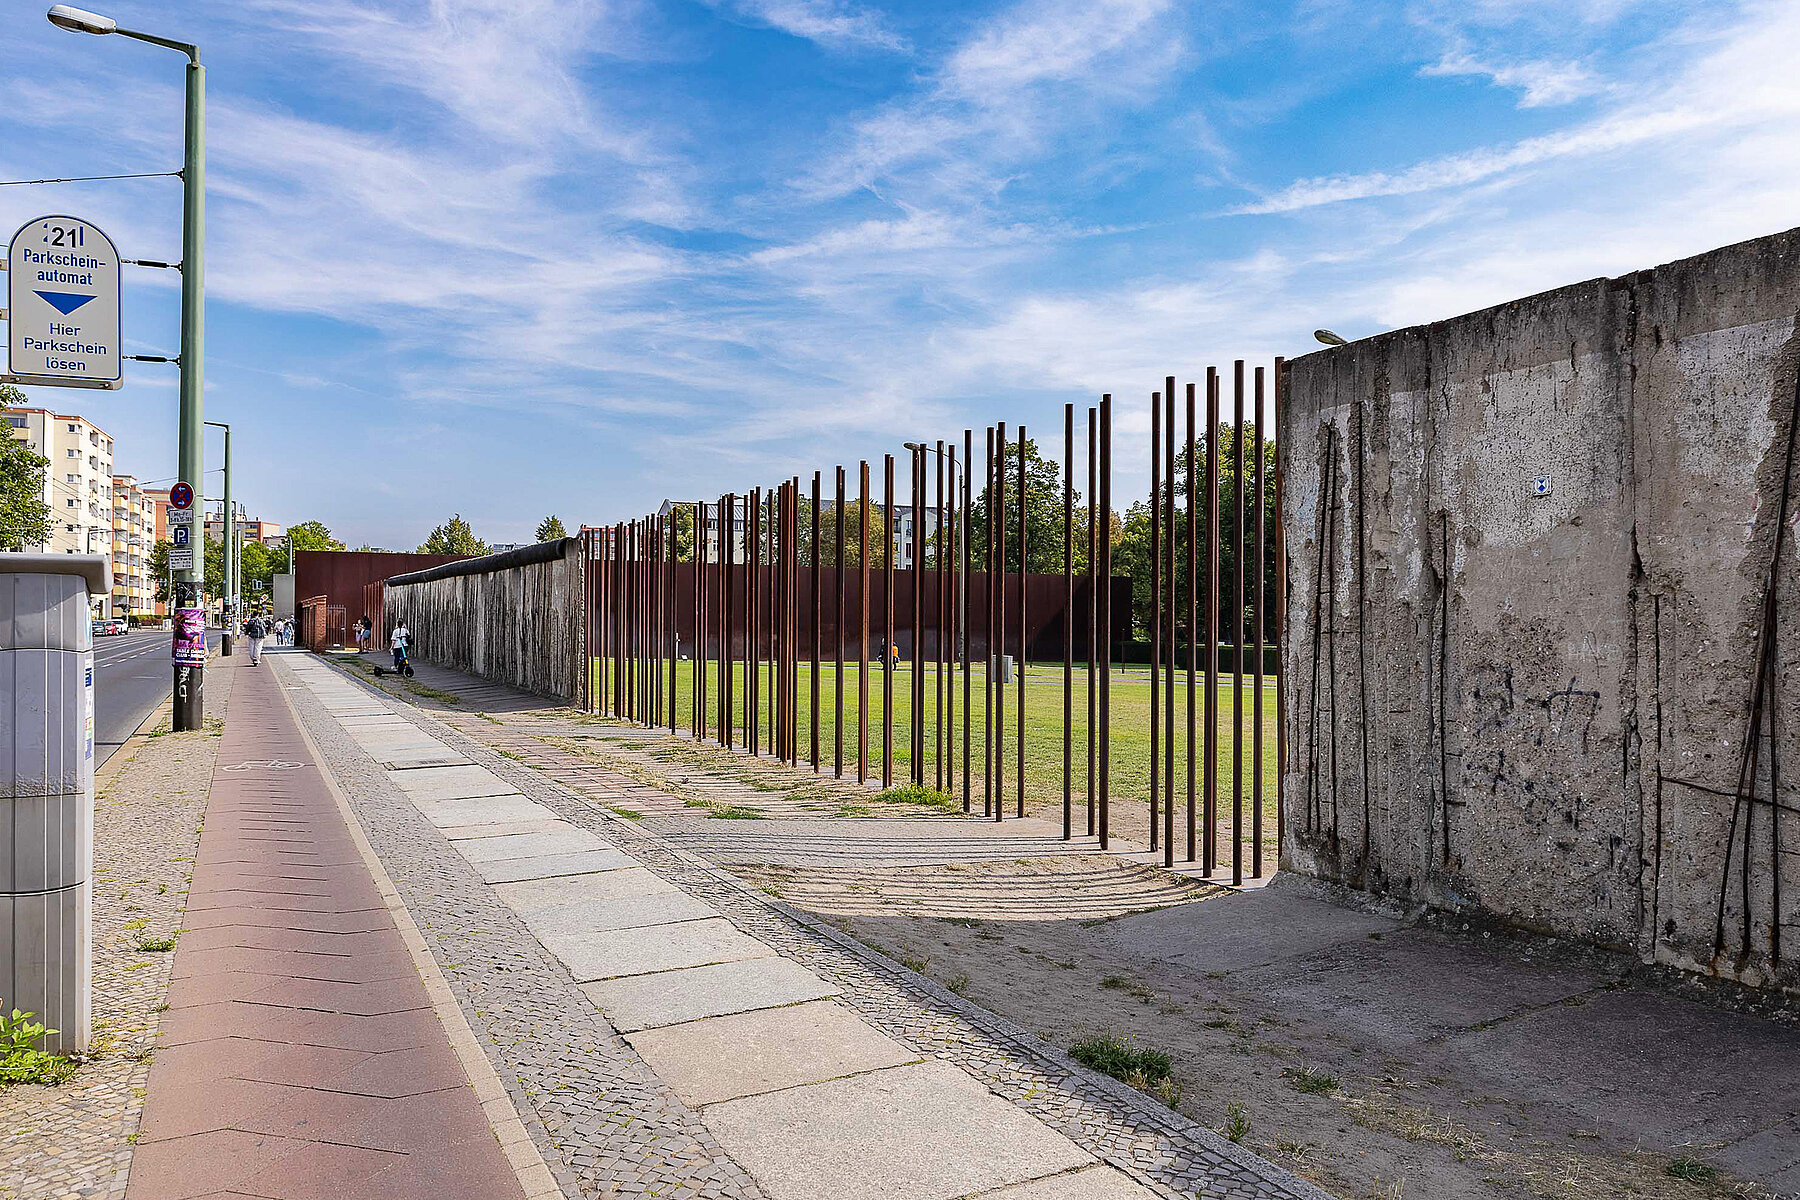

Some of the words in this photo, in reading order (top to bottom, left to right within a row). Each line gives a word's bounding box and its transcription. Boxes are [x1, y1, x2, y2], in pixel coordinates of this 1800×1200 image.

[23, 248, 106, 269] Parkschein-
[37, 269, 93, 285] automat
[49, 322, 81, 336] Hier
[24, 337, 107, 354] Parkschein
[46, 356, 86, 371] lösen
[177, 530, 186, 543] P
